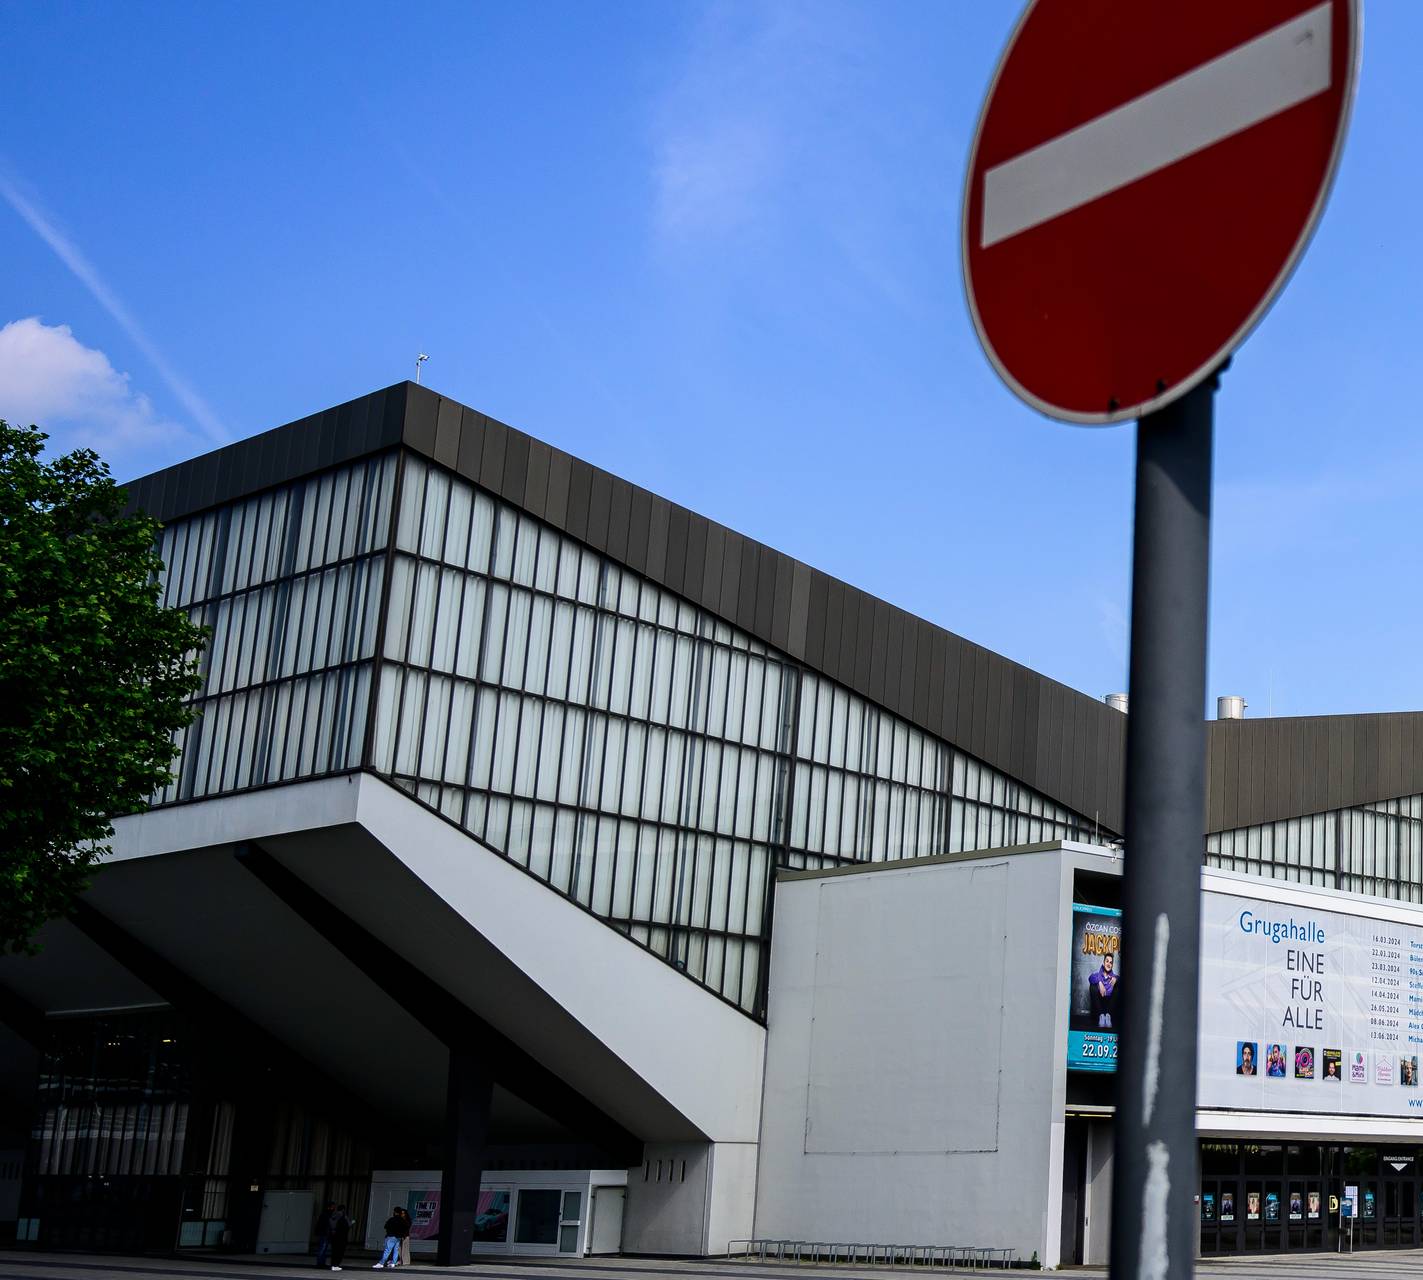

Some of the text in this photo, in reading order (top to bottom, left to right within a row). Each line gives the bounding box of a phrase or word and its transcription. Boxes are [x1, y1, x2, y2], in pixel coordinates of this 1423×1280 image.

[1086, 922, 1108, 932] ÖZCAN
[1240, 911, 1325, 943] Grugahalle
[1082, 933, 1120, 955] JACKP
[1372, 935, 1400, 945] 16.03.2024
[1372, 949, 1400, 959] 22.03.2024
[1287, 950, 1324, 974] EINE
[1372, 962, 1400, 972] 23.03.2024
[1372, 977, 1400, 986] 12.04.2024
[1291, 976, 1323, 1002] FÜR
[1371, 990, 1399, 1000] 14.04.2024
[1371, 1004, 1399, 1013] 26.05.2024
[1282, 1006, 1323, 1030] ALLE
[1371, 1018, 1399, 1027] 08.06.2024
[1371, 1032, 1399, 1041] 13.06.2024
[1082, 1044, 1118, 1057] 22.09.2
